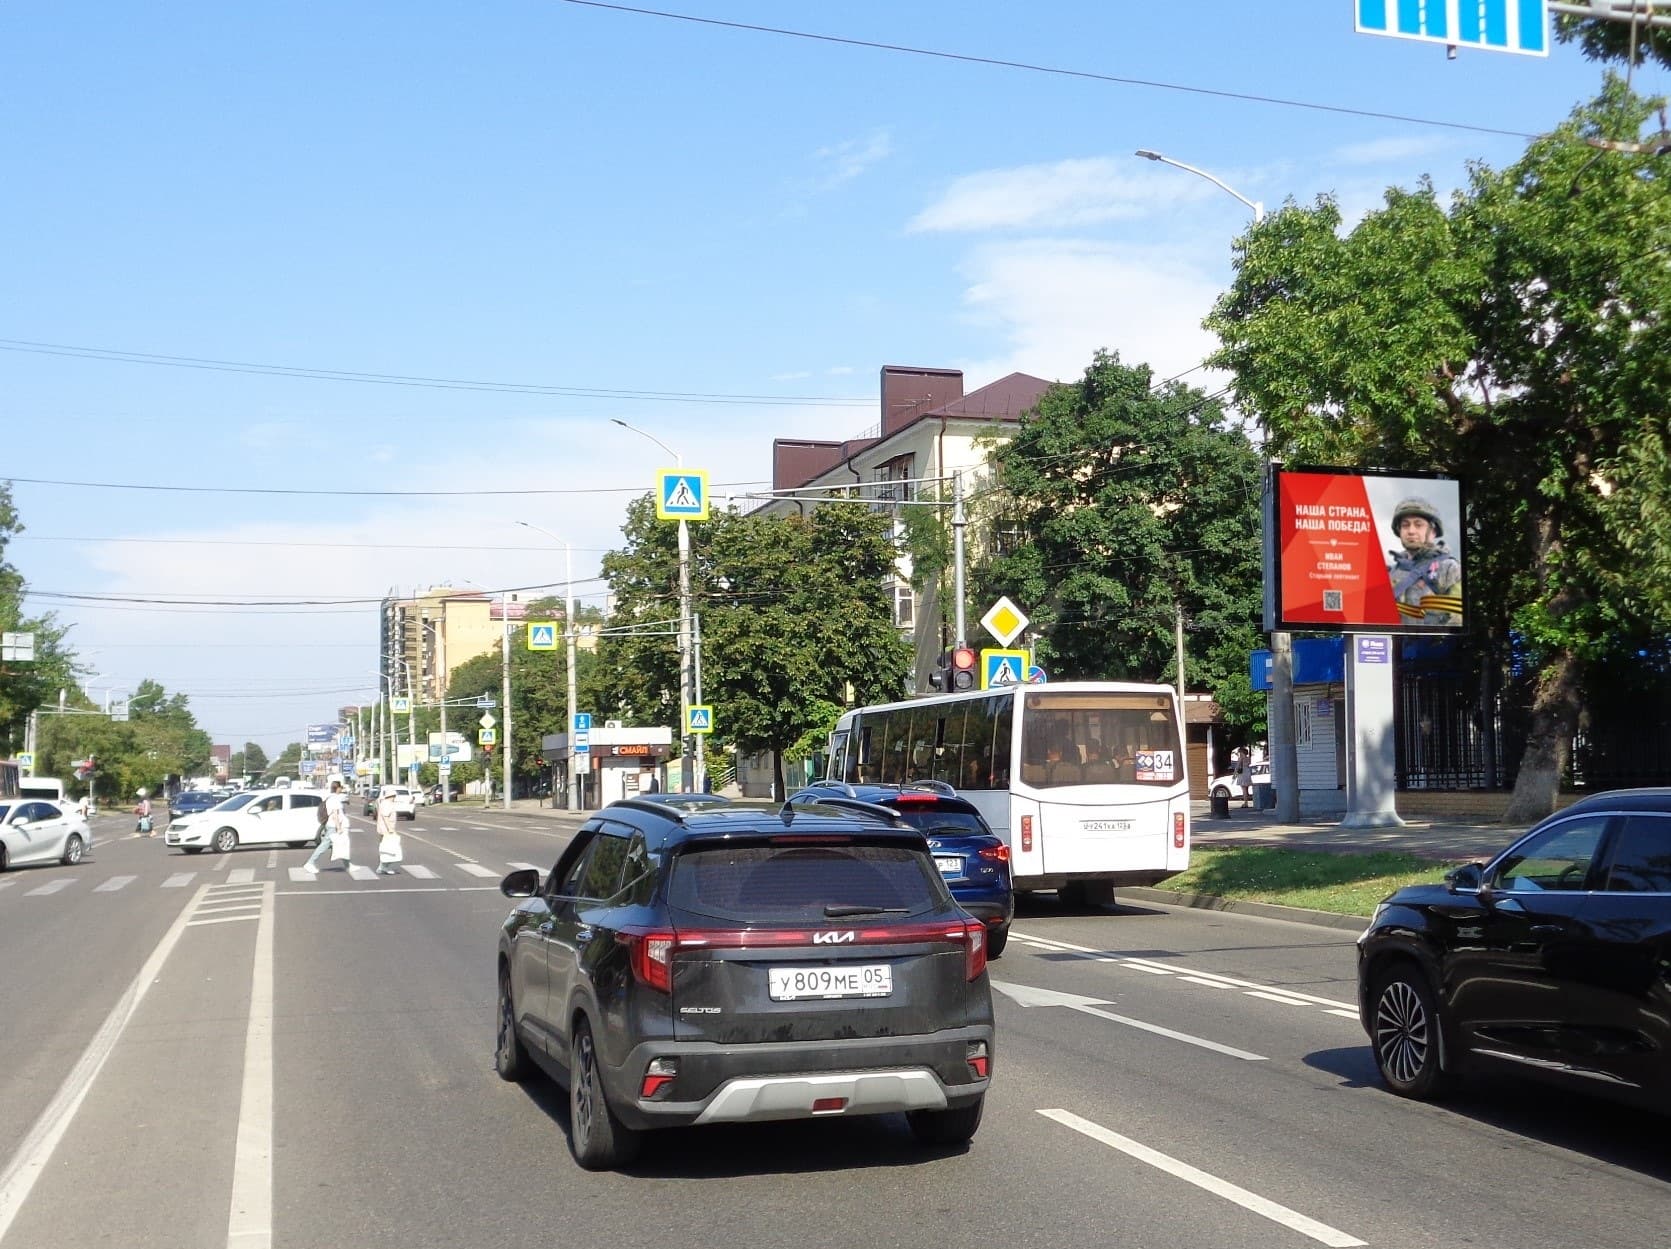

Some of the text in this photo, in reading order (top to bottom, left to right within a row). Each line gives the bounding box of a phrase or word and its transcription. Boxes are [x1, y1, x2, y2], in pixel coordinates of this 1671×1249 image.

[1295, 504, 1370, 519] НАША СТРАНА,
[1295, 518, 1371, 533] НАША ПОБЕДА!
[1155, 754, 1172, 769] 34
[813, 930, 855, 945] KIA
[781, 968, 883, 992] У809МЕ 05
[679, 1006, 722, 1015] SELTOS
